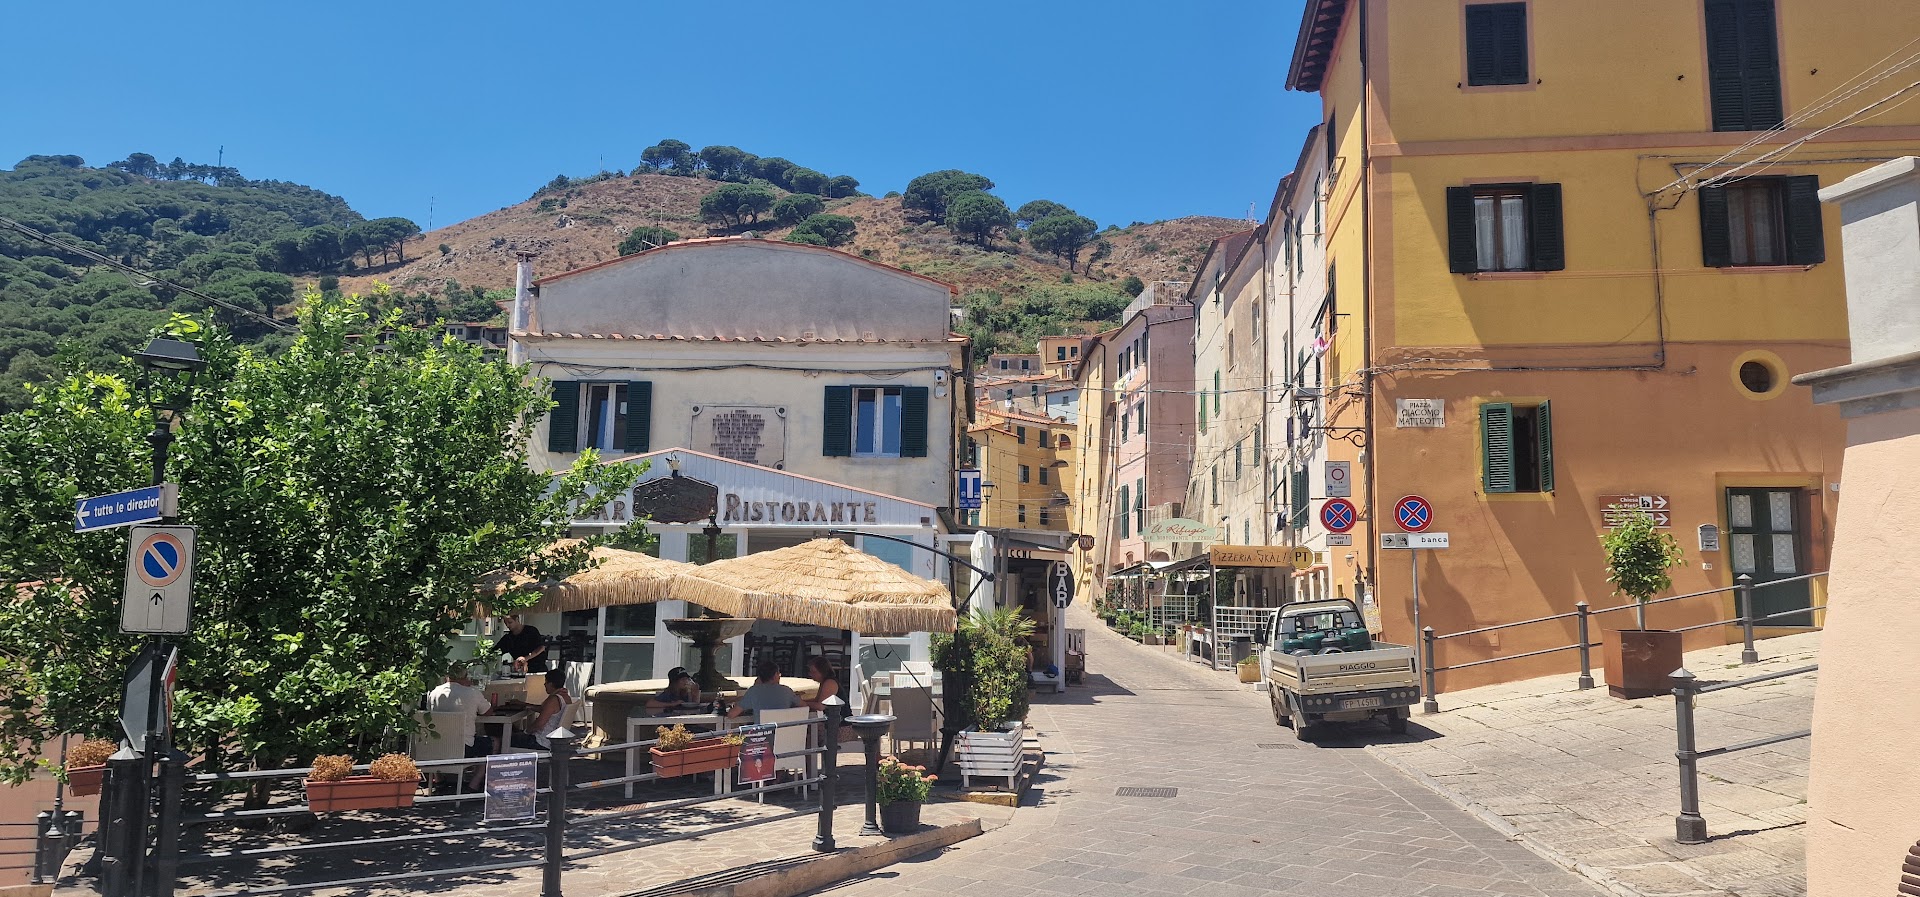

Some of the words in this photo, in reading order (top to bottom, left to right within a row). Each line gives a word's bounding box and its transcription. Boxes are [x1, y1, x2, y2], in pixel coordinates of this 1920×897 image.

[1401, 408, 1440, 417] GIACOMO
[1398, 417, 1444, 426] MATTEOTTI
[961, 472, 980, 498] T
[94, 505, 113, 517] tutte
[116, 502, 124, 513] le
[723, 493, 876, 522] RISTORANTE
[1213, 548, 1252, 562] PIZZERIA
[1295, 551, 1308, 562] PT
[1056, 561, 1068, 609] BAR
[1339, 661, 1376, 672] PIAGGIO
[1344, 701, 1354, 709] FP
